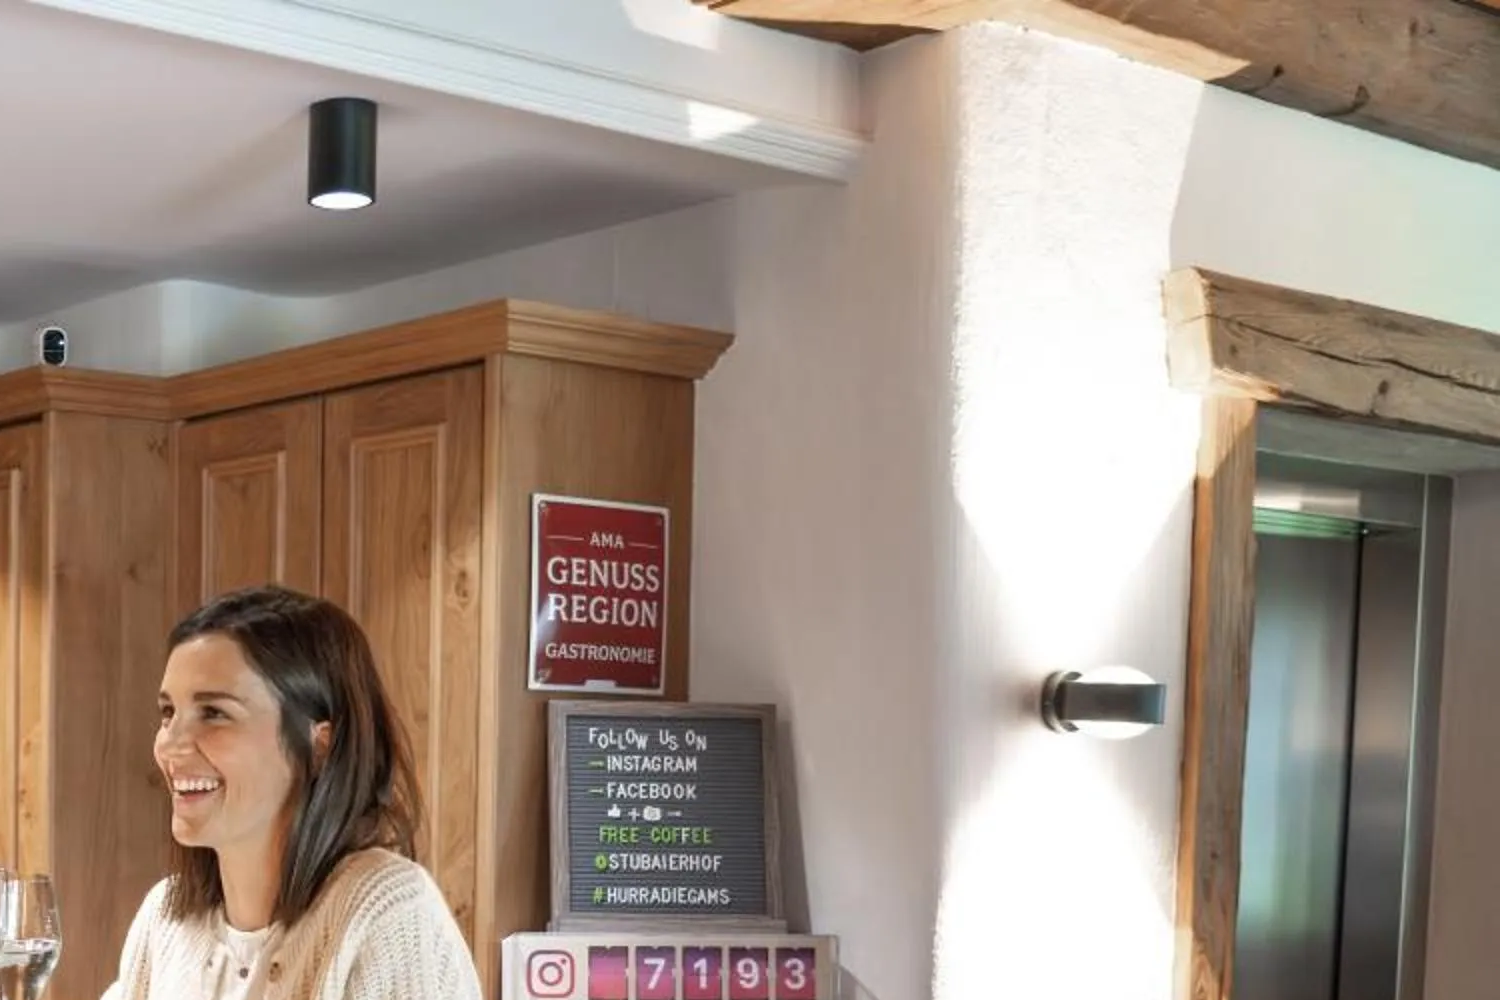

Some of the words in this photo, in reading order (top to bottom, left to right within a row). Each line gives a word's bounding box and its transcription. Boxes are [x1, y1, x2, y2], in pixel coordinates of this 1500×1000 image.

[589, 531, 625, 548] AMA
[547, 555, 660, 593] GENUSS
[547, 593, 658, 628] REGION
[544, 642, 656, 664] GASTRONOMIE
[589, 727, 648, 750] FOLLOW
[659, 729, 679, 750] US
[685, 729, 707, 750] ON
[599, 826, 640, 843] FREE
[651, 826, 712, 844] COFFEE
[593, 886, 730, 904] #HURRADIEGAMS
